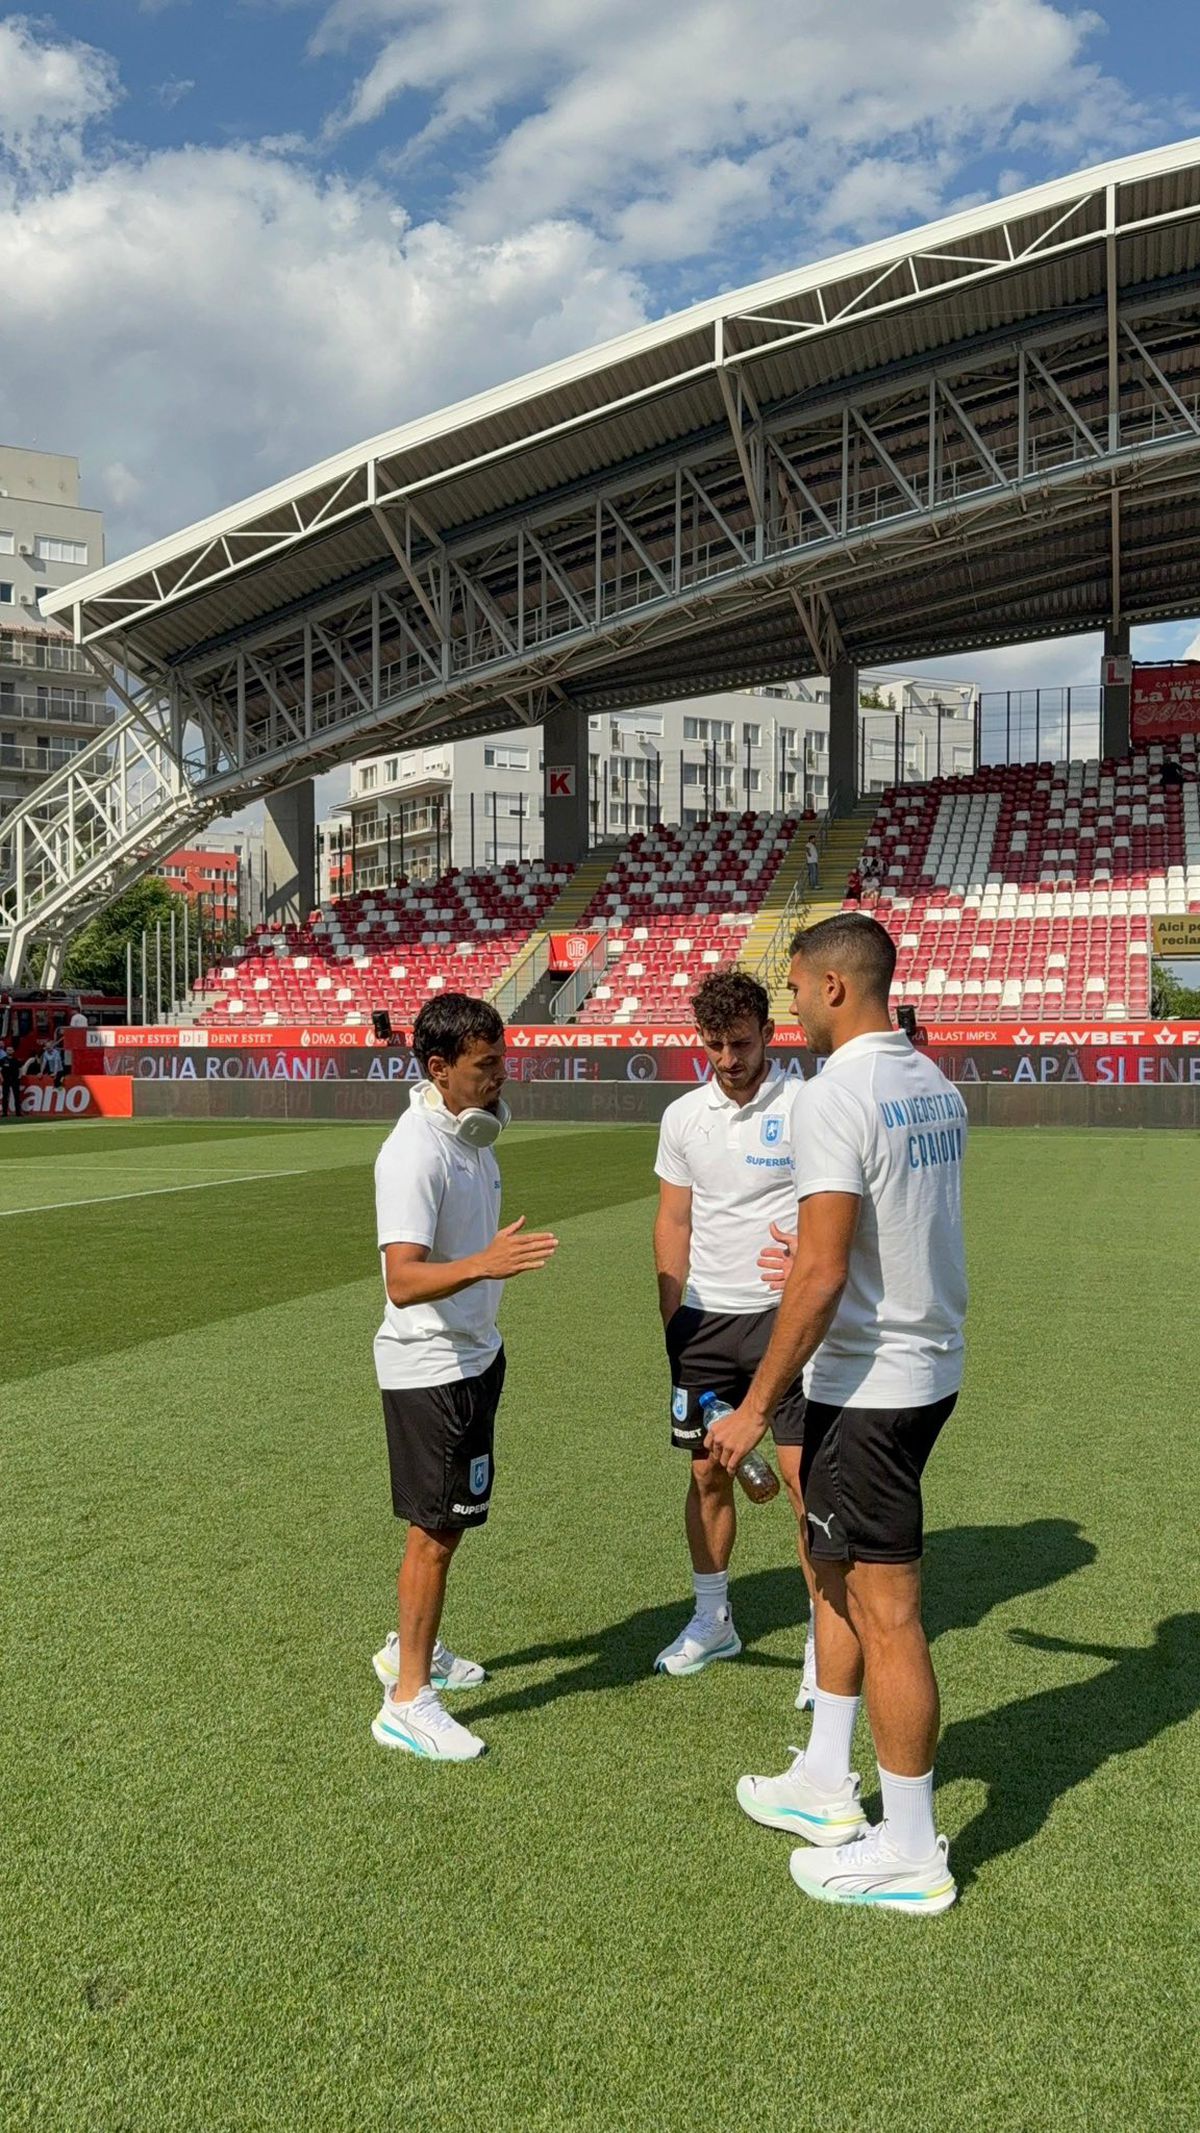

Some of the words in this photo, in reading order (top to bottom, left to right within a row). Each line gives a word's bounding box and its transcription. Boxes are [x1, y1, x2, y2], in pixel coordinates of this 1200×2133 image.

[1107, 663, 1125, 684] L
[1134, 690, 1164, 703] La
[550, 773, 571, 795] K
[1158, 922, 1184, 932] Aici
[118, 1034, 145, 1044] DENT
[148, 1034, 178, 1044] ESTET
[211, 1034, 239, 1044] DENT
[241, 1033, 273, 1044] ESTET
[311, 1033, 336, 1045] DIVA
[339, 1033, 358, 1045] SOL
[534, 1034, 622, 1047] FAVBET
[652, 1033, 704, 1047] FAV
[928, 1032, 964, 1041] BALAST
[966, 1032, 997, 1041] IMPEX
[1039, 1031, 1145, 1045] FAVBET
[206, 1051, 340, 1080] ROMÂNIA
[504, 1057, 587, 1080] ERGIE
[1013, 1049, 1085, 1082] APĂ
[452, 1501, 490, 1515] SUPER
